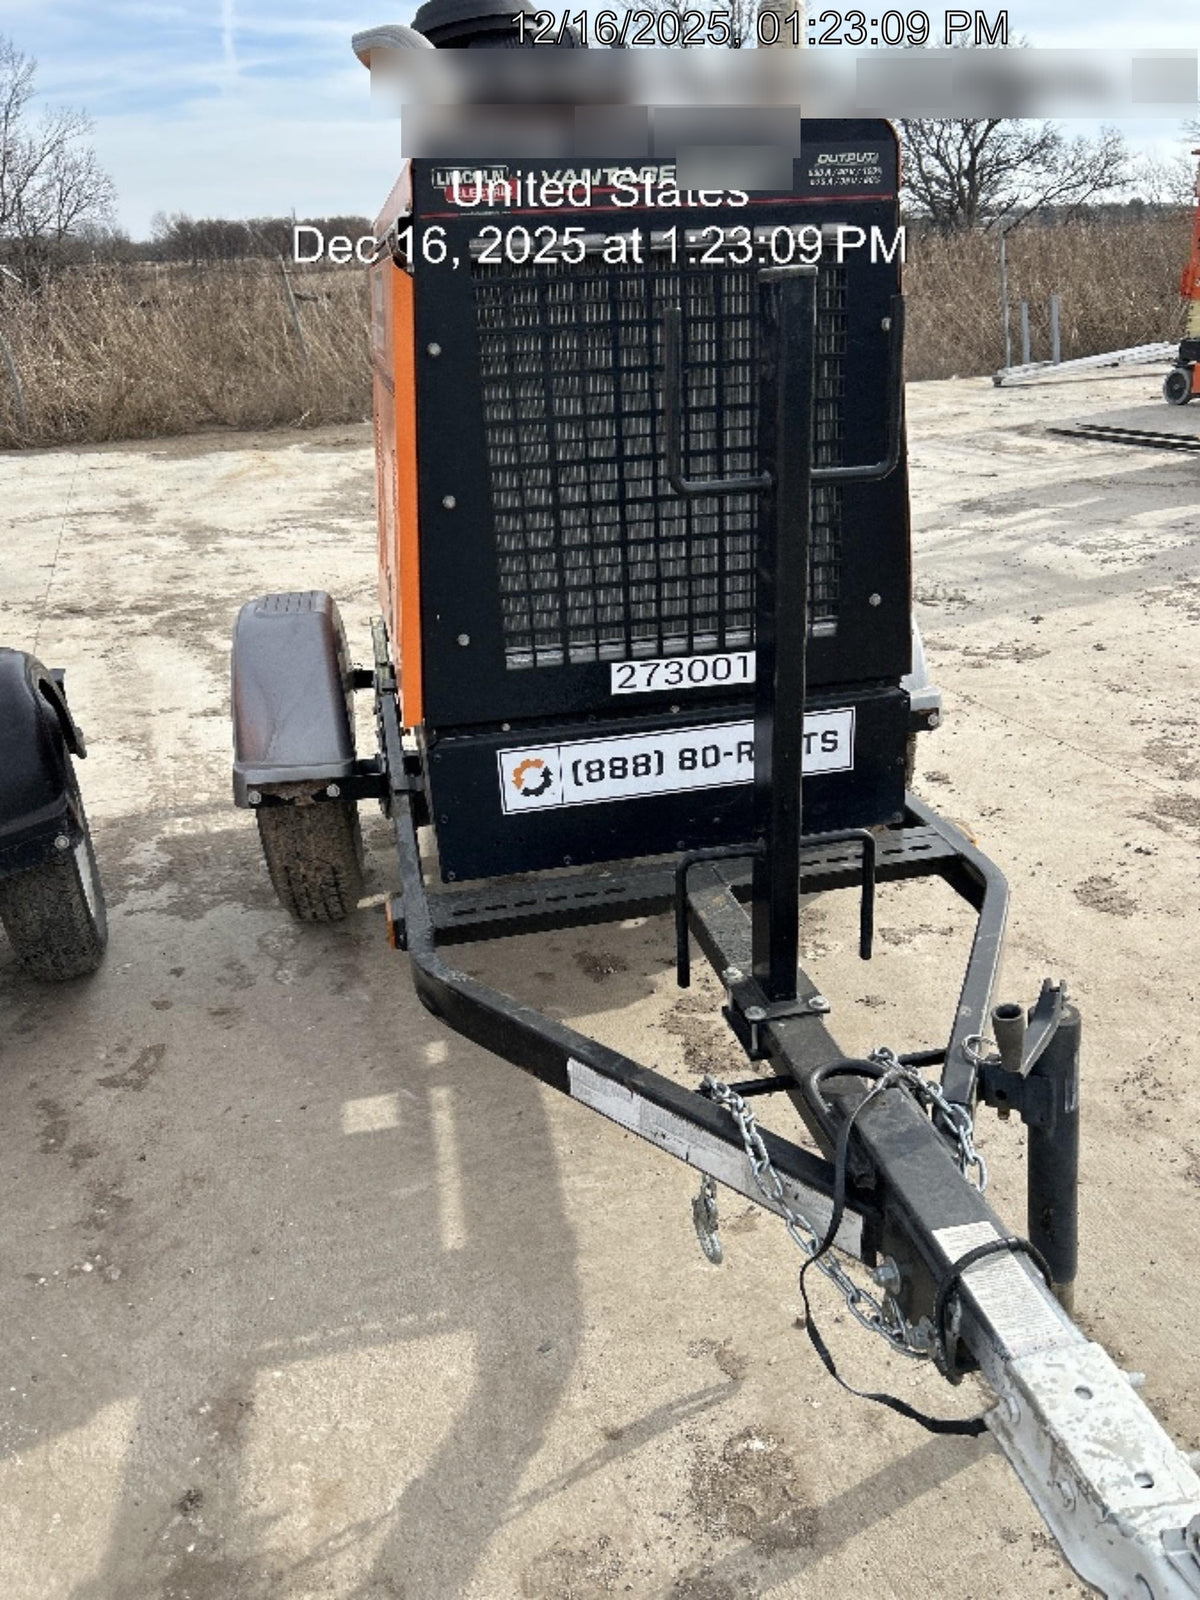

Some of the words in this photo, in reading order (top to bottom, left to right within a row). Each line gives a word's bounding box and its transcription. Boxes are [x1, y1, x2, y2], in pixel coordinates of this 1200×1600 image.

[616, 655, 749, 690] 273001
[571, 749, 665, 787] (888)
[678, 729, 839, 772] 80-RTS
